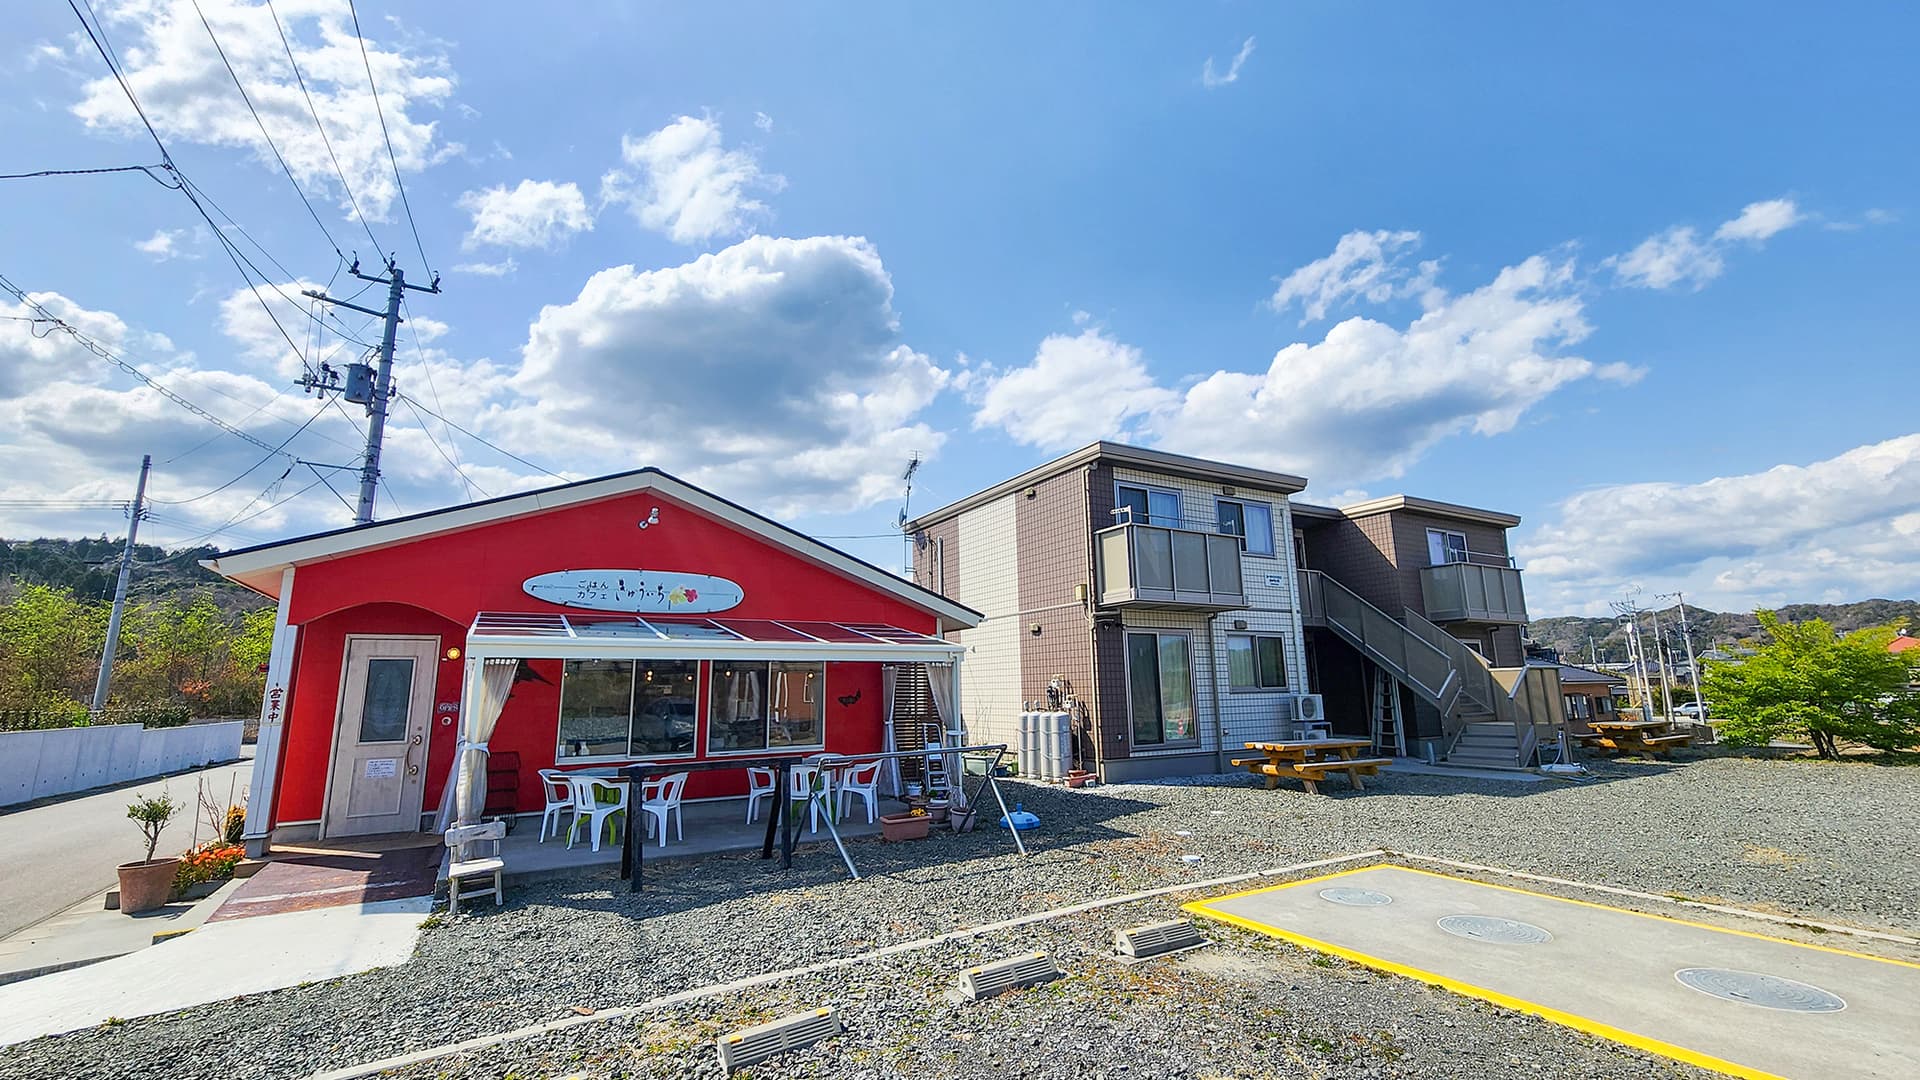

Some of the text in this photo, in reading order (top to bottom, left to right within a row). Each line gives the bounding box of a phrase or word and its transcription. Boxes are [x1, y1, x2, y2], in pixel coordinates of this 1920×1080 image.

[578, 580, 608, 590] ごはん
[577, 591, 607, 600] カフェ
[268, 687, 284, 723] 営業中
